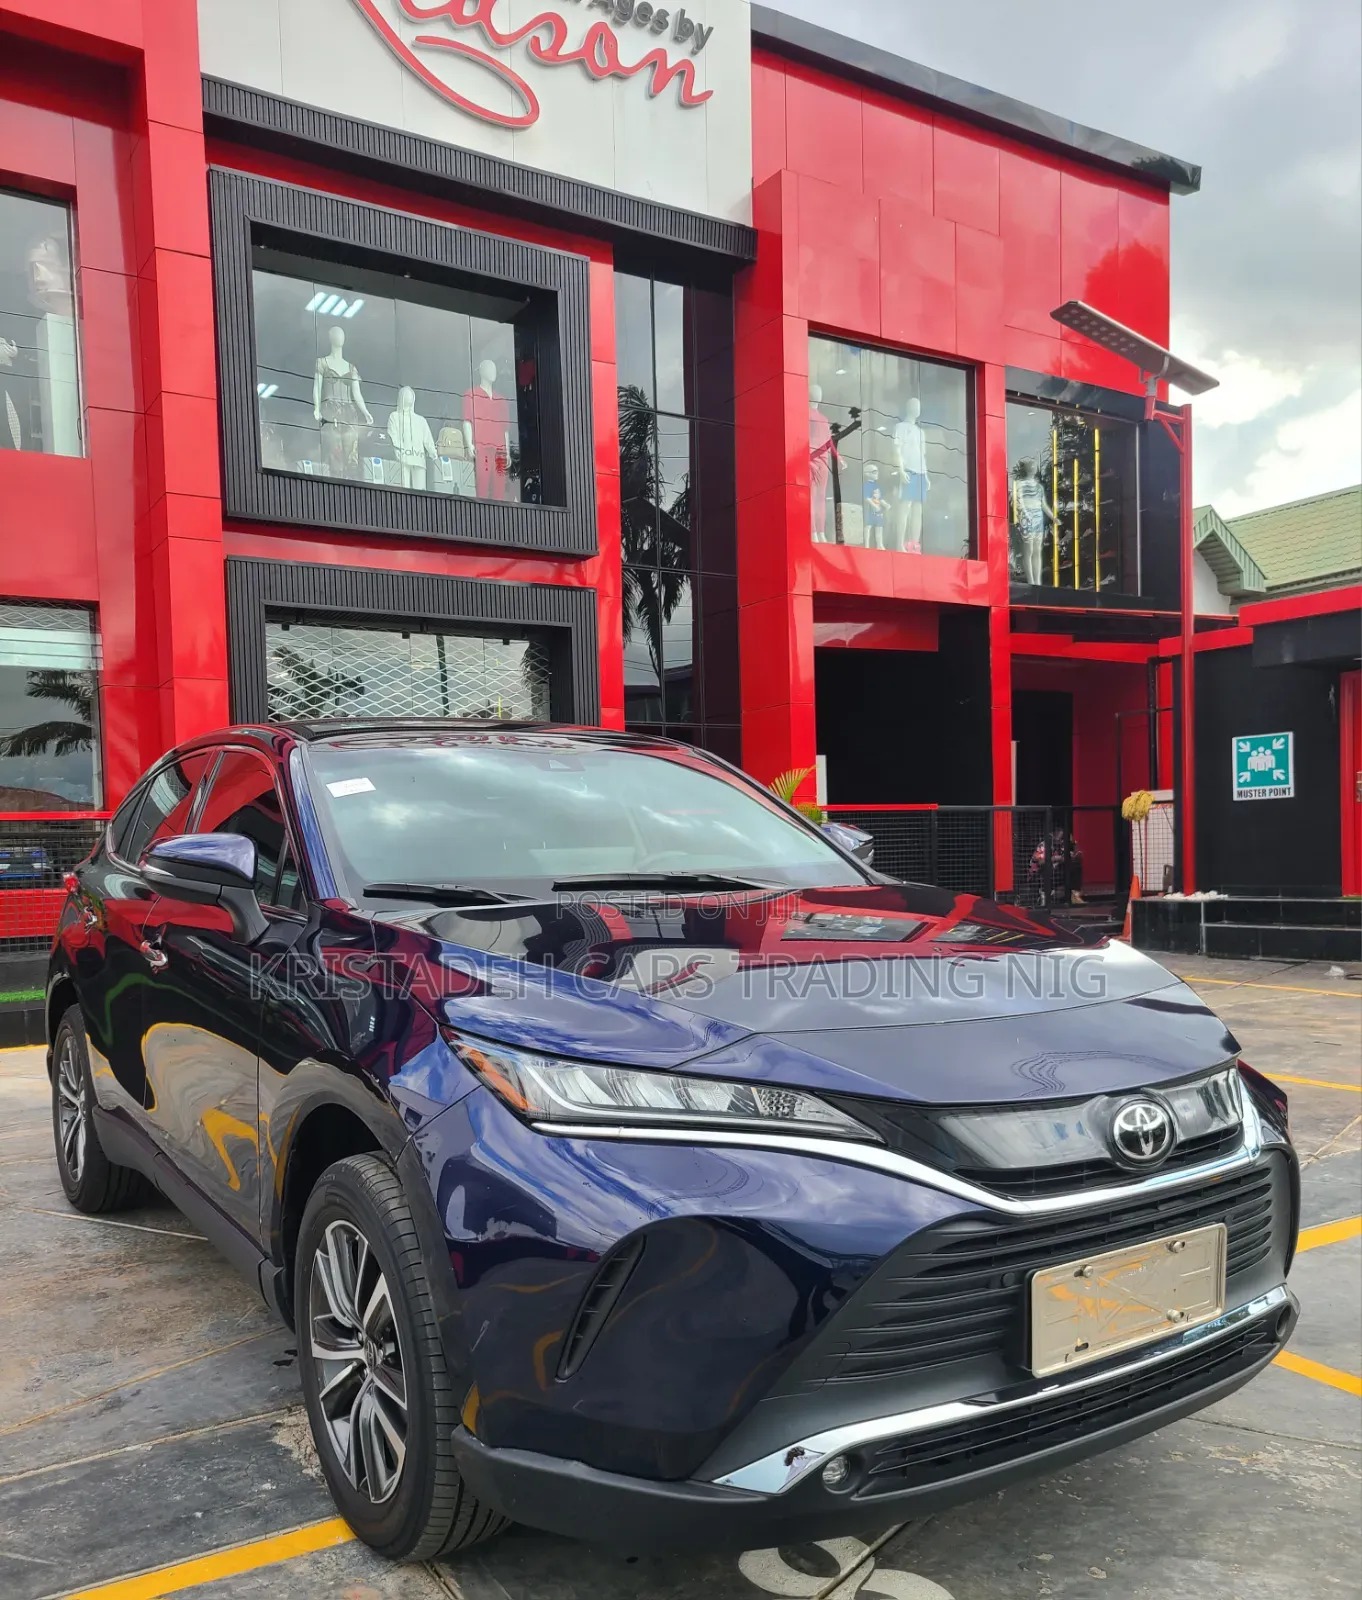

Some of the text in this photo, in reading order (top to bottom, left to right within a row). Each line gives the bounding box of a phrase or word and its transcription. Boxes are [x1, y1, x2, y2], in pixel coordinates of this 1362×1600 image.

[672, 8, 714, 55] by
[1236, 787, 1291, 798] MUSTER POINT
